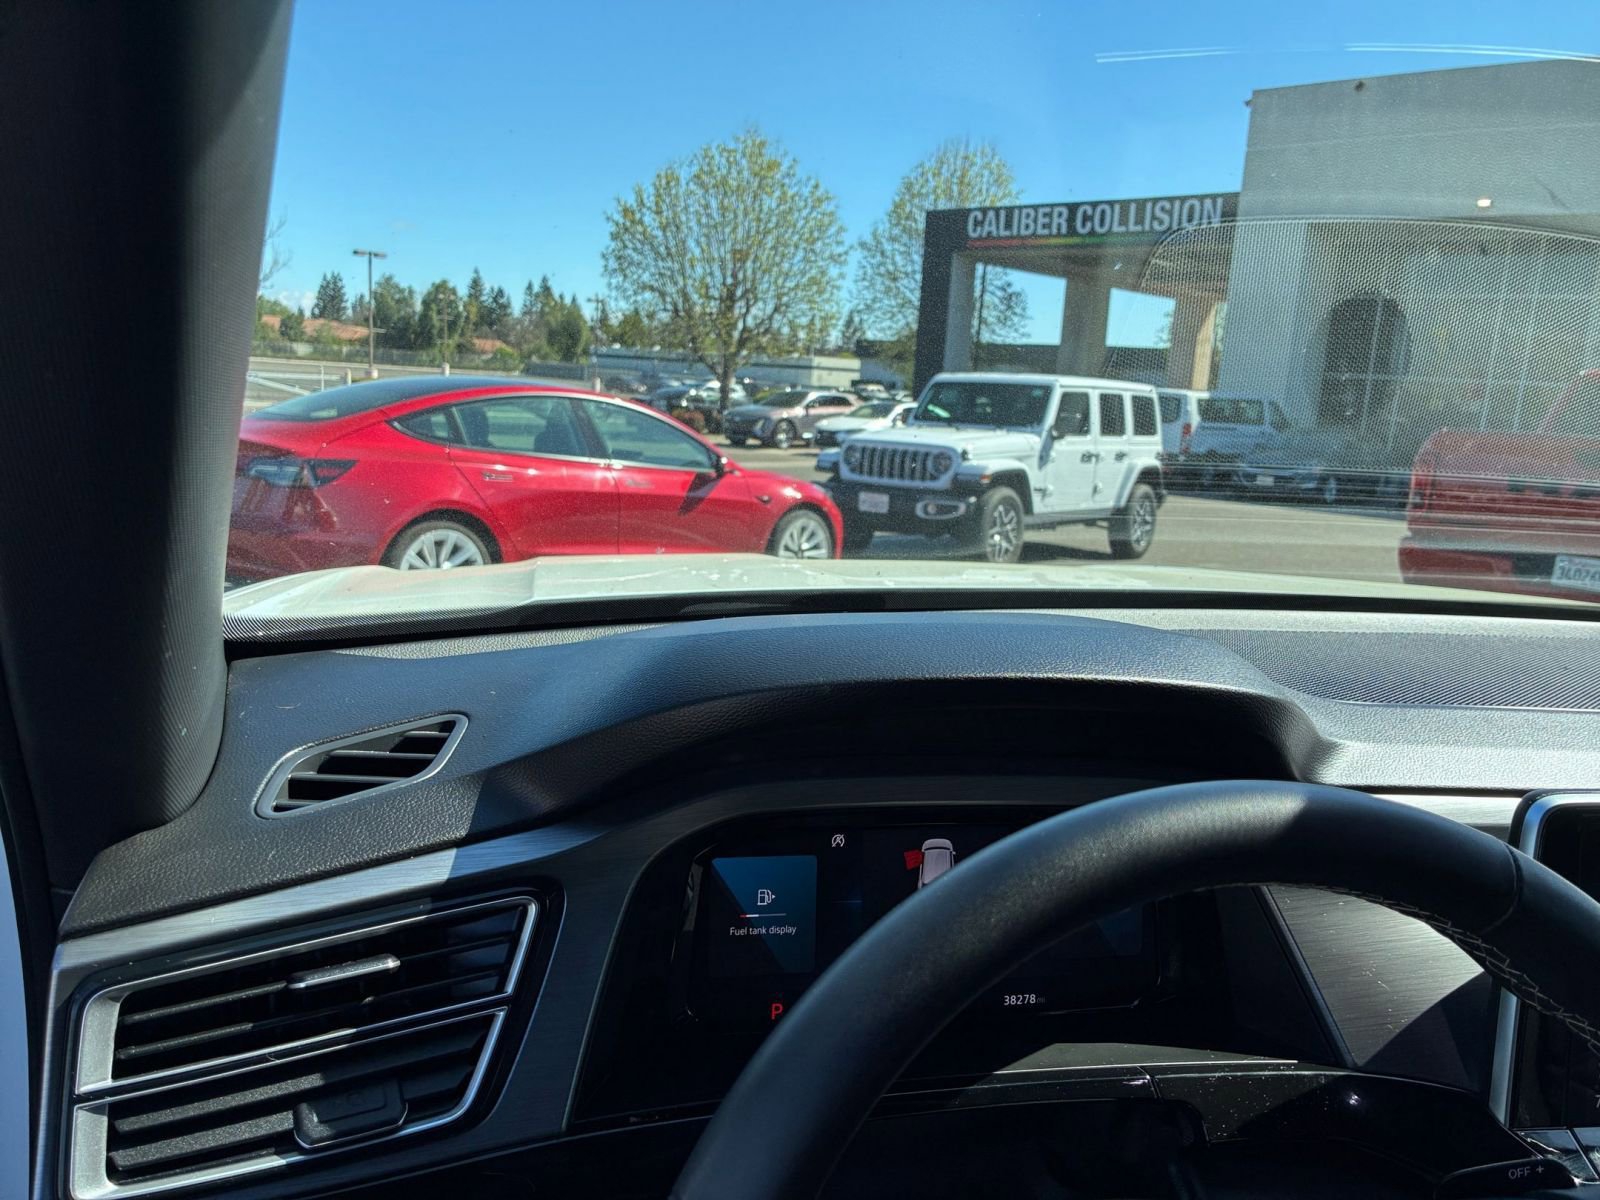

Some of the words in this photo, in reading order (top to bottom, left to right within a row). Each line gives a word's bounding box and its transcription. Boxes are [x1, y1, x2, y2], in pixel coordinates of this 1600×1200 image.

[966, 206, 1069, 238] CALIBER
[1075, 198, 1223, 234] COLLISION
[729, 926, 748, 936] Fuel
[749, 925, 767, 935] tank
[768, 924, 797, 936] display
[1003, 993, 1036, 1006] 38278
[771, 1003, 783, 1020] P
[1508, 1166, 1531, 1180] OFF
